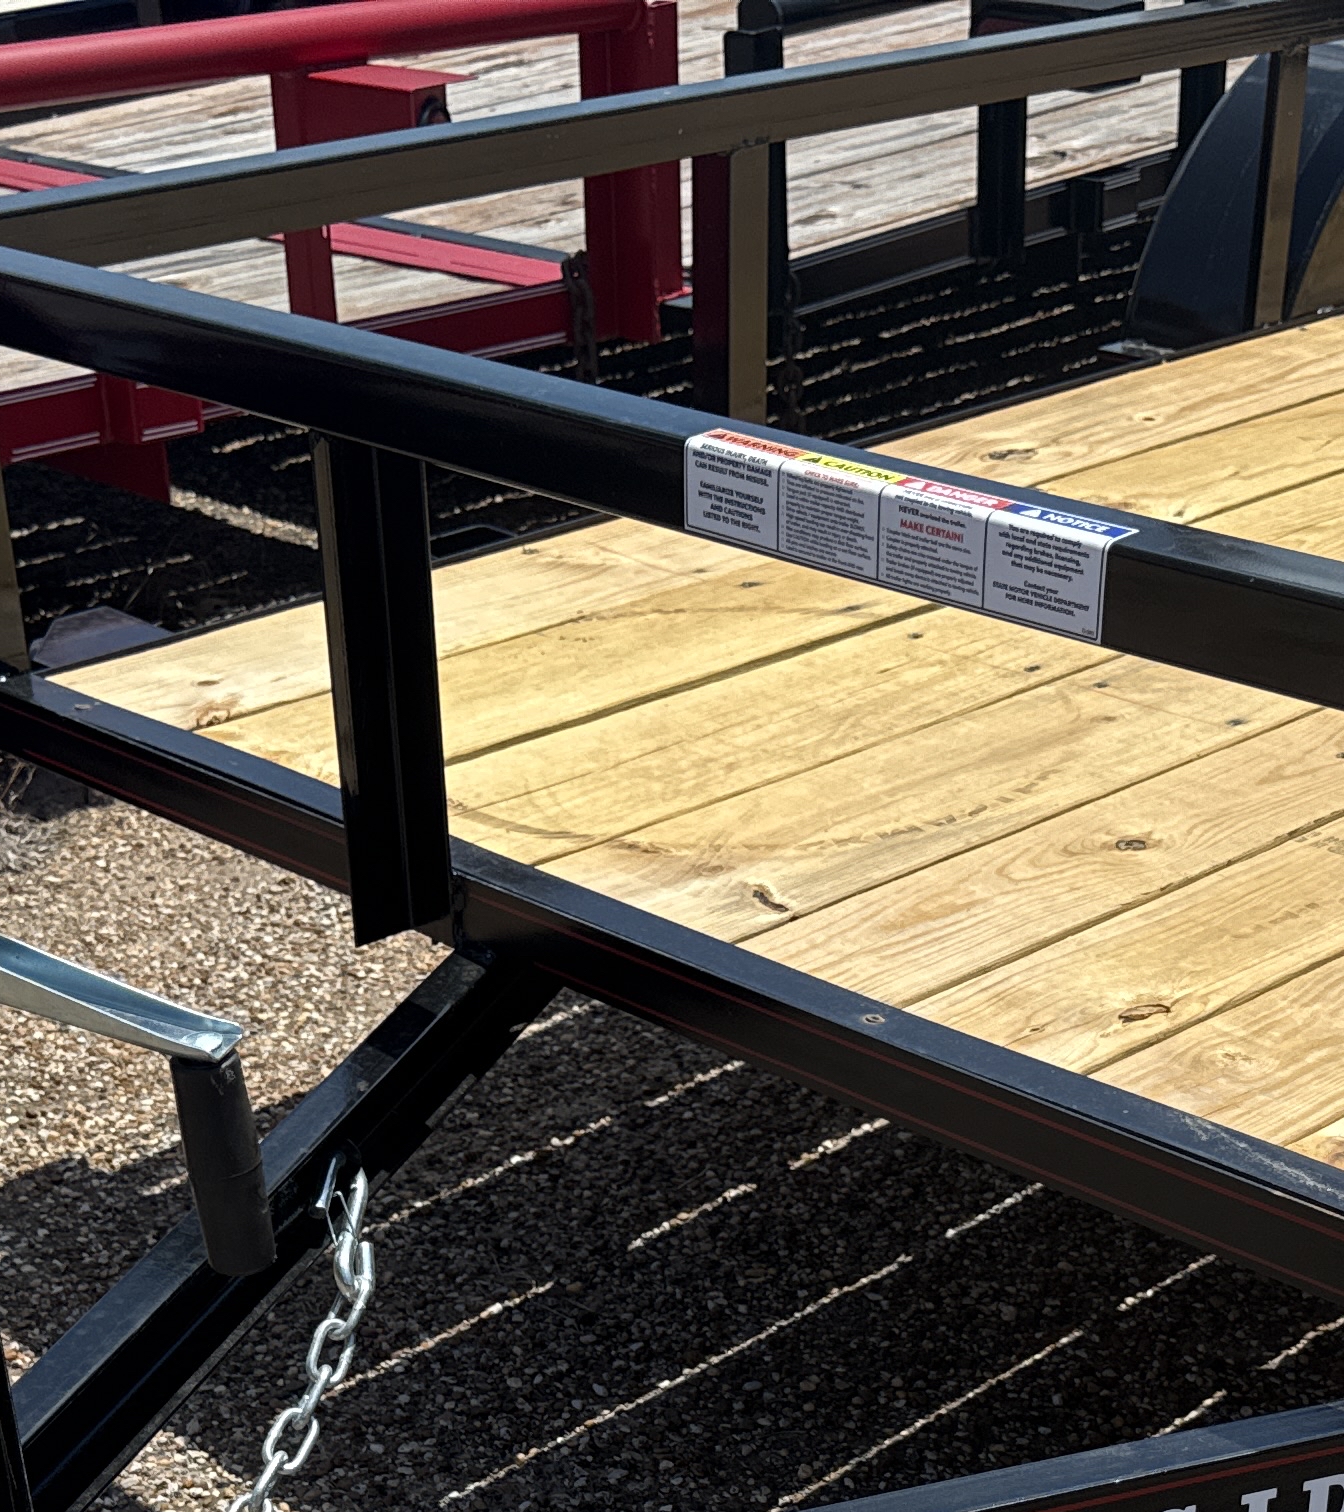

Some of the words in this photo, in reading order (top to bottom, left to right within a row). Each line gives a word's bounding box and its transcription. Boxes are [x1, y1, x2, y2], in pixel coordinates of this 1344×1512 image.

[727, 435, 801, 458] WARNING
[823, 460, 895, 481] CAUTION
[926, 484, 999, 506] DANGER
[899, 518, 925, 534] MAKE
[925, 525, 965, 544] CERTAIN!
[1042, 513, 1111, 534] NOTICE
